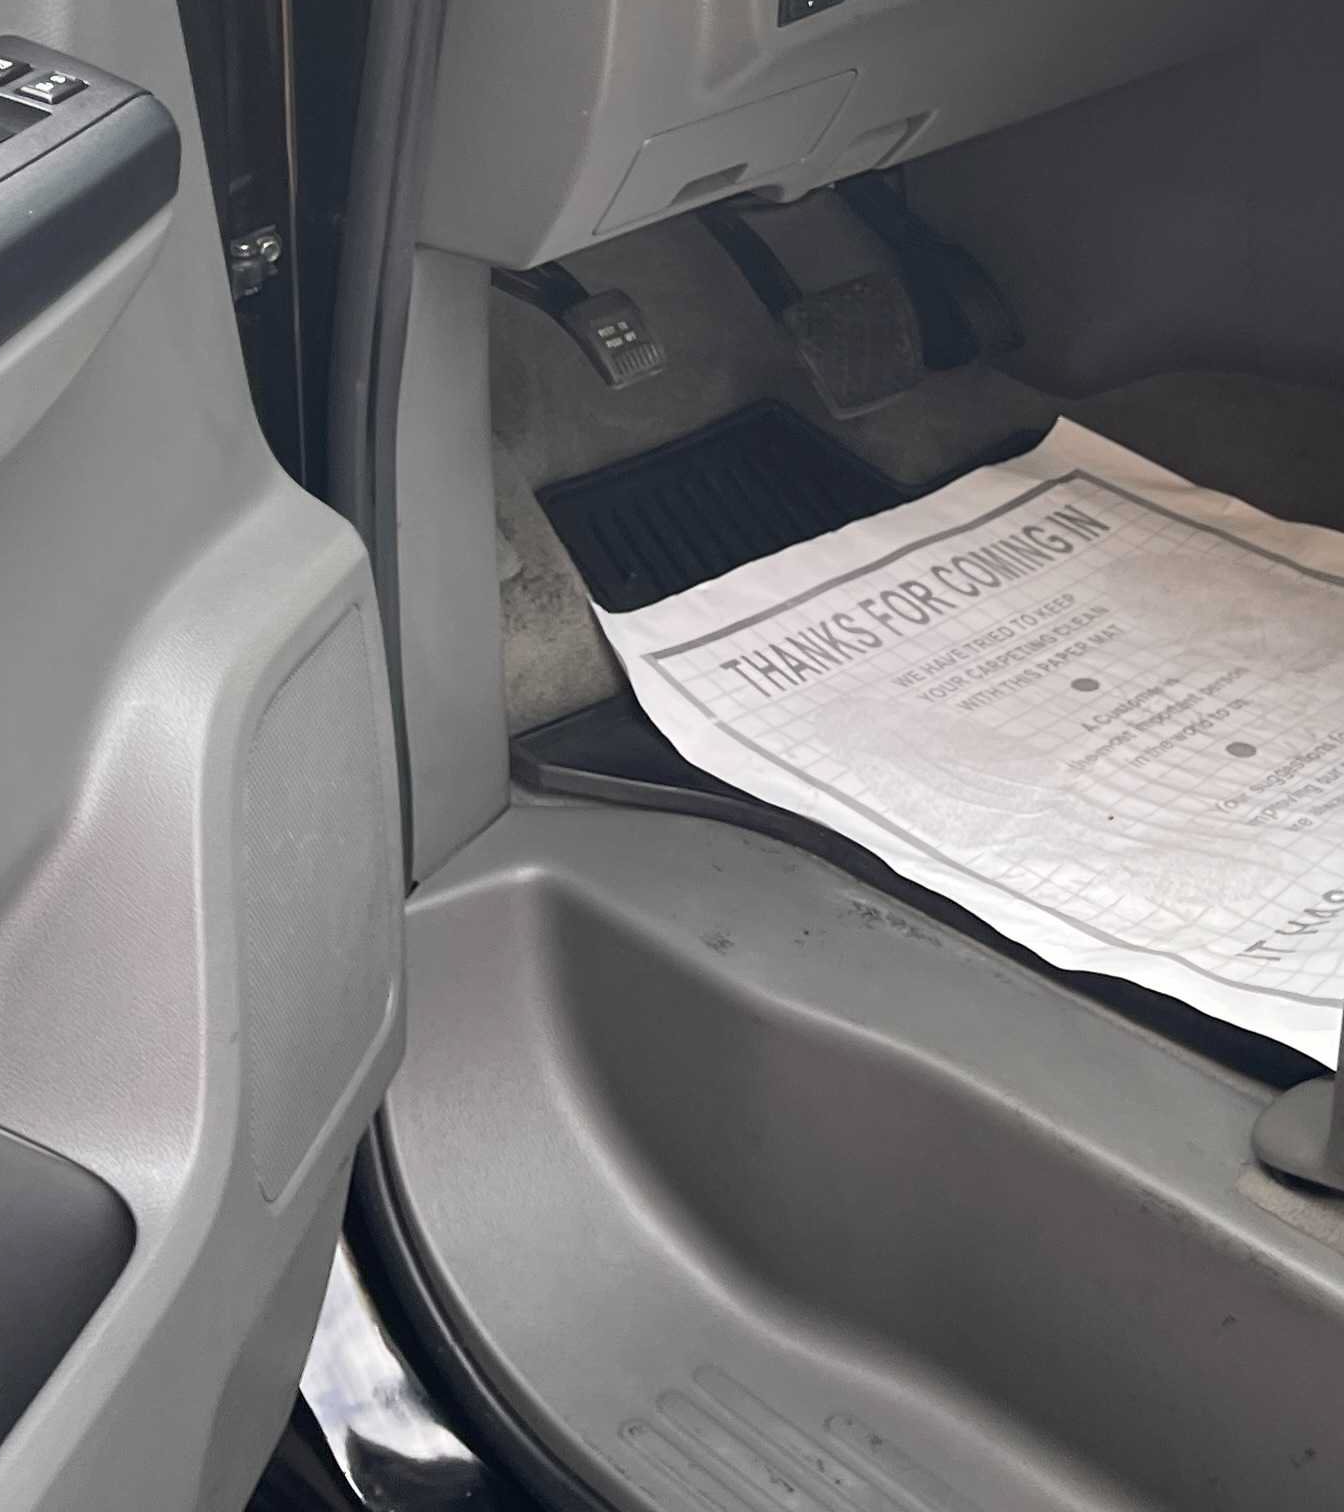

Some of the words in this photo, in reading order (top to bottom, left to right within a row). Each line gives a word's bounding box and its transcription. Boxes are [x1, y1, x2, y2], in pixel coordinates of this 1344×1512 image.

[720, 611, 883, 698] THANKS
[858, 580, 956, 637] FOR
[931, 524, 1074, 598] COMING
[1052, 503, 1111, 542] IN
[892, 668, 927, 688] WE
[920, 649, 969, 677] HAVE
[962, 626, 1016, 656] TRIED
[1010, 613, 1039, 631] TO
[1035, 593, 1076, 620] KEEP
[917, 675, 971, 703] YOUR
[965, 633, 1057, 680] CARPETING
[1053, 605, 1111, 637] CLEAN
[957, 685, 1005, 712] WITH
[999, 667, 1042, 692] THIS
[1037, 641, 1089, 674] PAPER
[1087, 623, 1125, 649] MAT
[1234, 939, 1297, 962] IT
